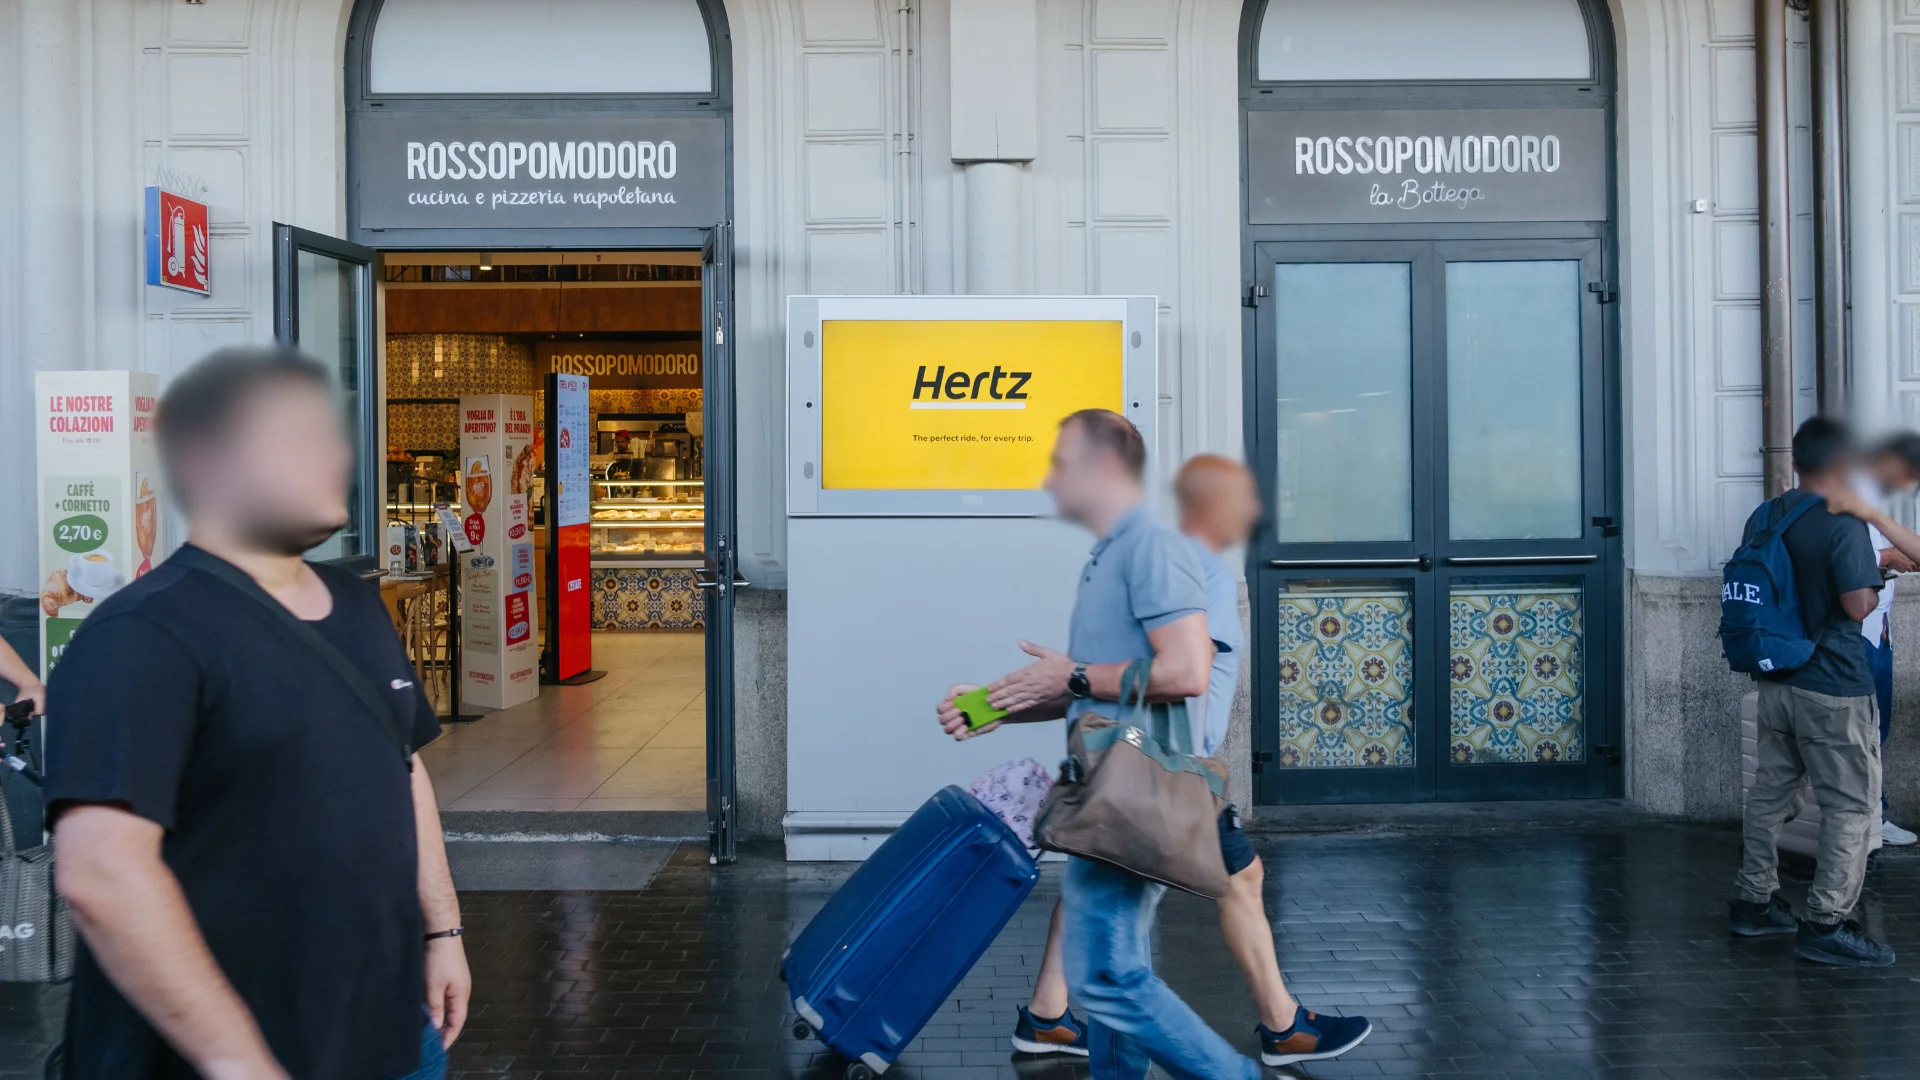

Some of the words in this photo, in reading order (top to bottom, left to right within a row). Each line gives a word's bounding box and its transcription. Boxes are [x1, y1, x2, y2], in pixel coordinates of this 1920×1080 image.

[407, 140, 677, 179] ROSSOPOMODORO
[1295, 135, 1560, 175] ROSSOPOMODORO
[408, 190, 470, 205] cucina
[475, 193, 485, 205] e
[491, 189, 566, 210] pizzeria
[573, 186, 676, 209] napoletana
[1370, 183, 1393, 206] la
[1397, 178, 1486, 210] Bottega
[551, 354, 698, 376] ROSSOPOMODORO
[912, 365, 1032, 400] Hertz
[50, 396, 63, 412] LE
[66, 396, 113, 412] NOSTRE
[466, 410, 486, 420] VOGLIA
[488, 410, 494, 420] DI
[50, 416, 114, 432] COLAZIONI
[464, 422, 496, 433] APERITIVO?
[912, 434, 928, 442] The
[930, 434, 958, 443] perfect
[960, 434, 979, 443] ride,
[980, 434, 991, 442] for
[1018, 435, 1034, 443] trip.
[66, 480, 95, 497] CAFFÈ
[62, 498, 110, 512] CORNETTO
